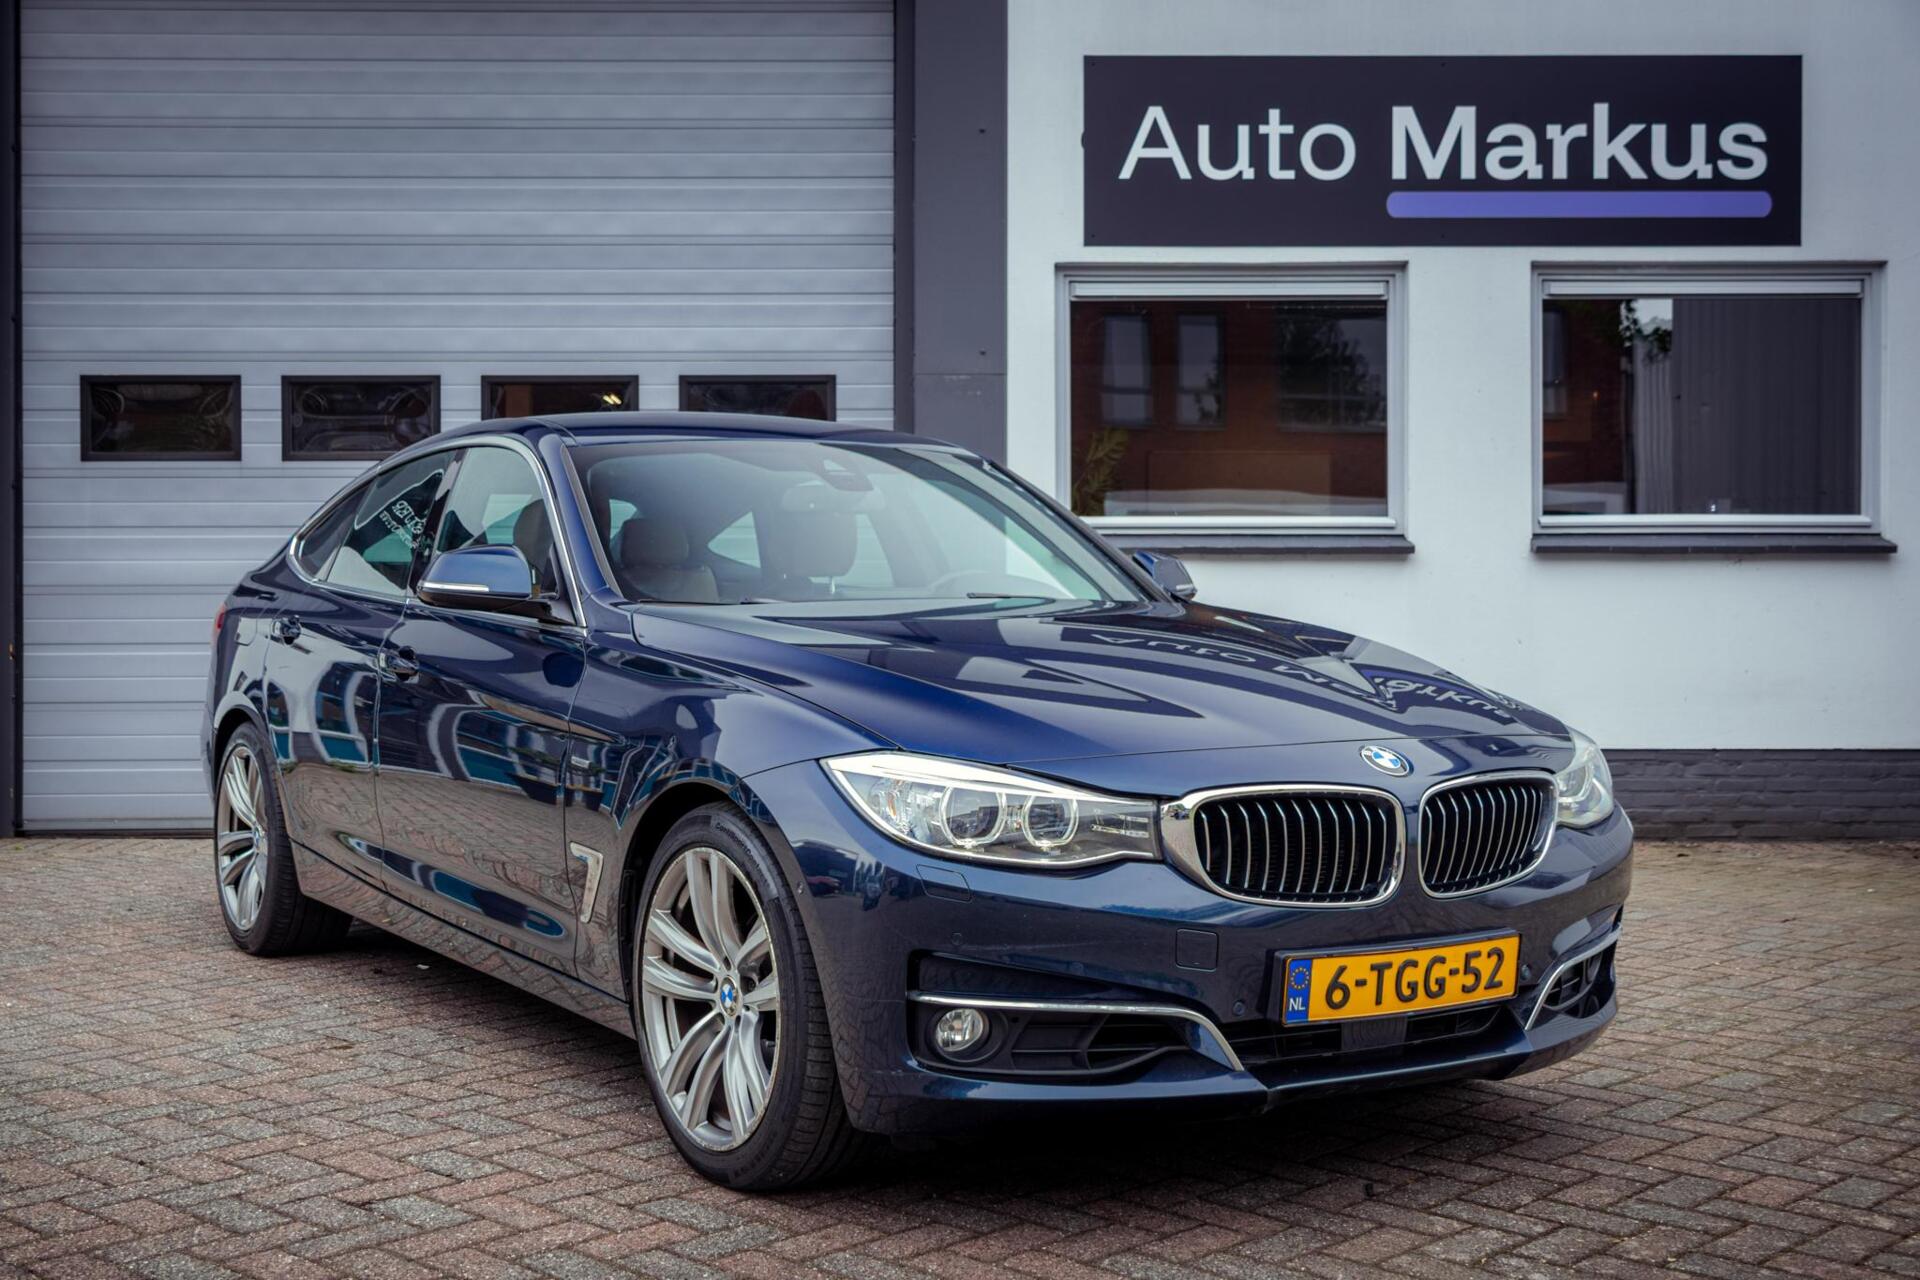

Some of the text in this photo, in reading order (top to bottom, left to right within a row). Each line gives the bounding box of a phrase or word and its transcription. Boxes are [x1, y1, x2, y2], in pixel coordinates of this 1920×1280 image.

[1119, 102, 1767, 181] Auto Markus
[1288, 997, 1306, 1012] NL
[1325, 946, 1505, 1010] 6-TGG-52
